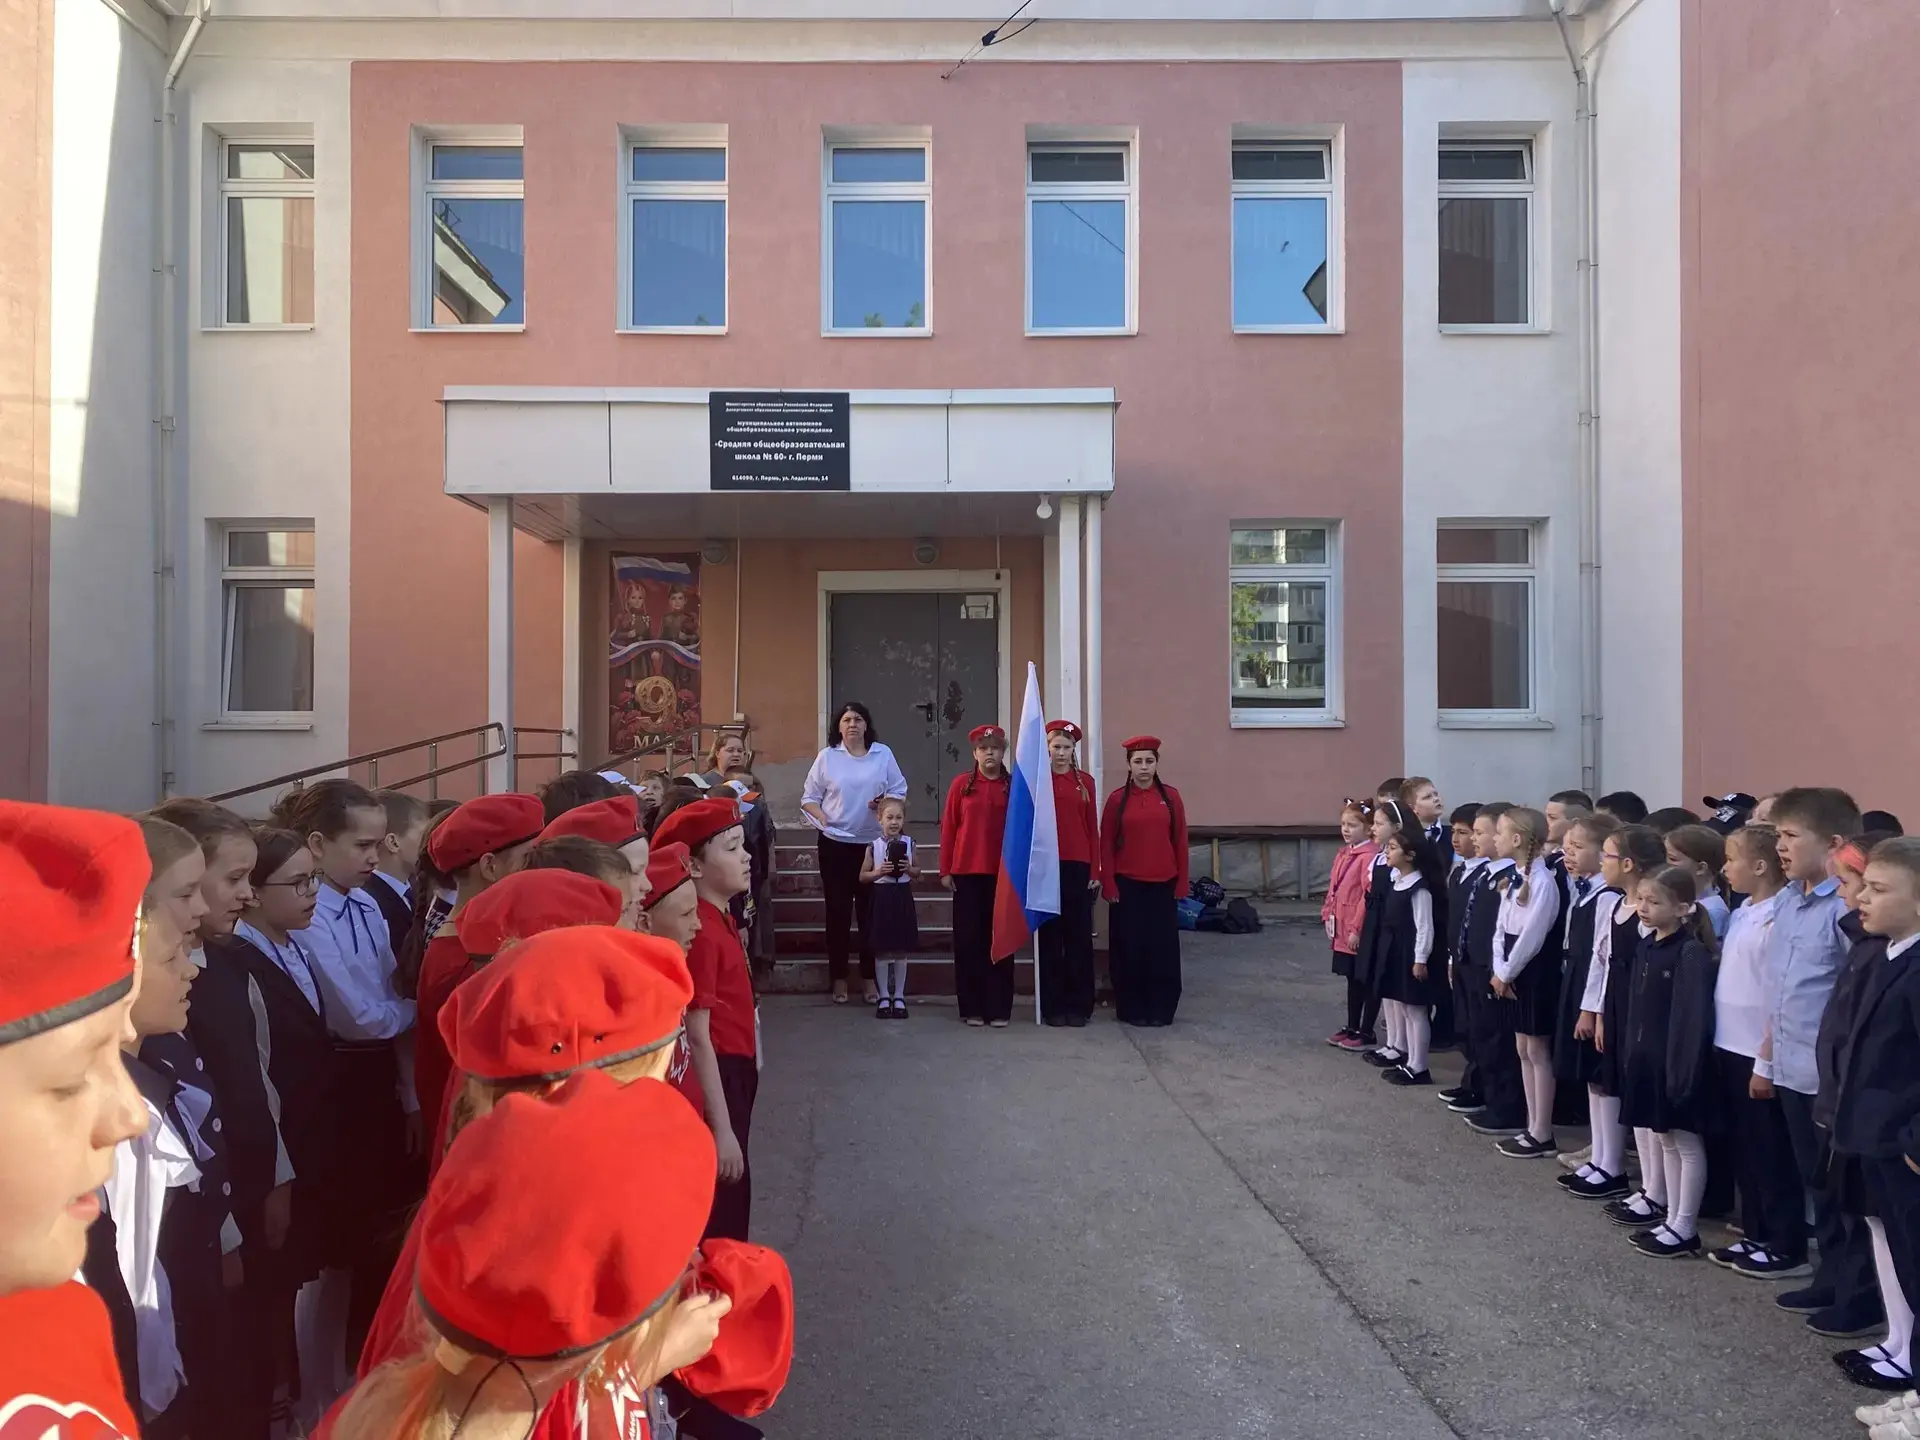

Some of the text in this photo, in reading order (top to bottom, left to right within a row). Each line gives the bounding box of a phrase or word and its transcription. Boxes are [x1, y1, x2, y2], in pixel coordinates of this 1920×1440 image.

[753, 440, 845, 449] общеобразовательная
[762, 452, 772, 460] №
[796, 453, 824, 462] Перми
[635, 676, 677, 732] 9
[633, 735, 676, 749] МА
